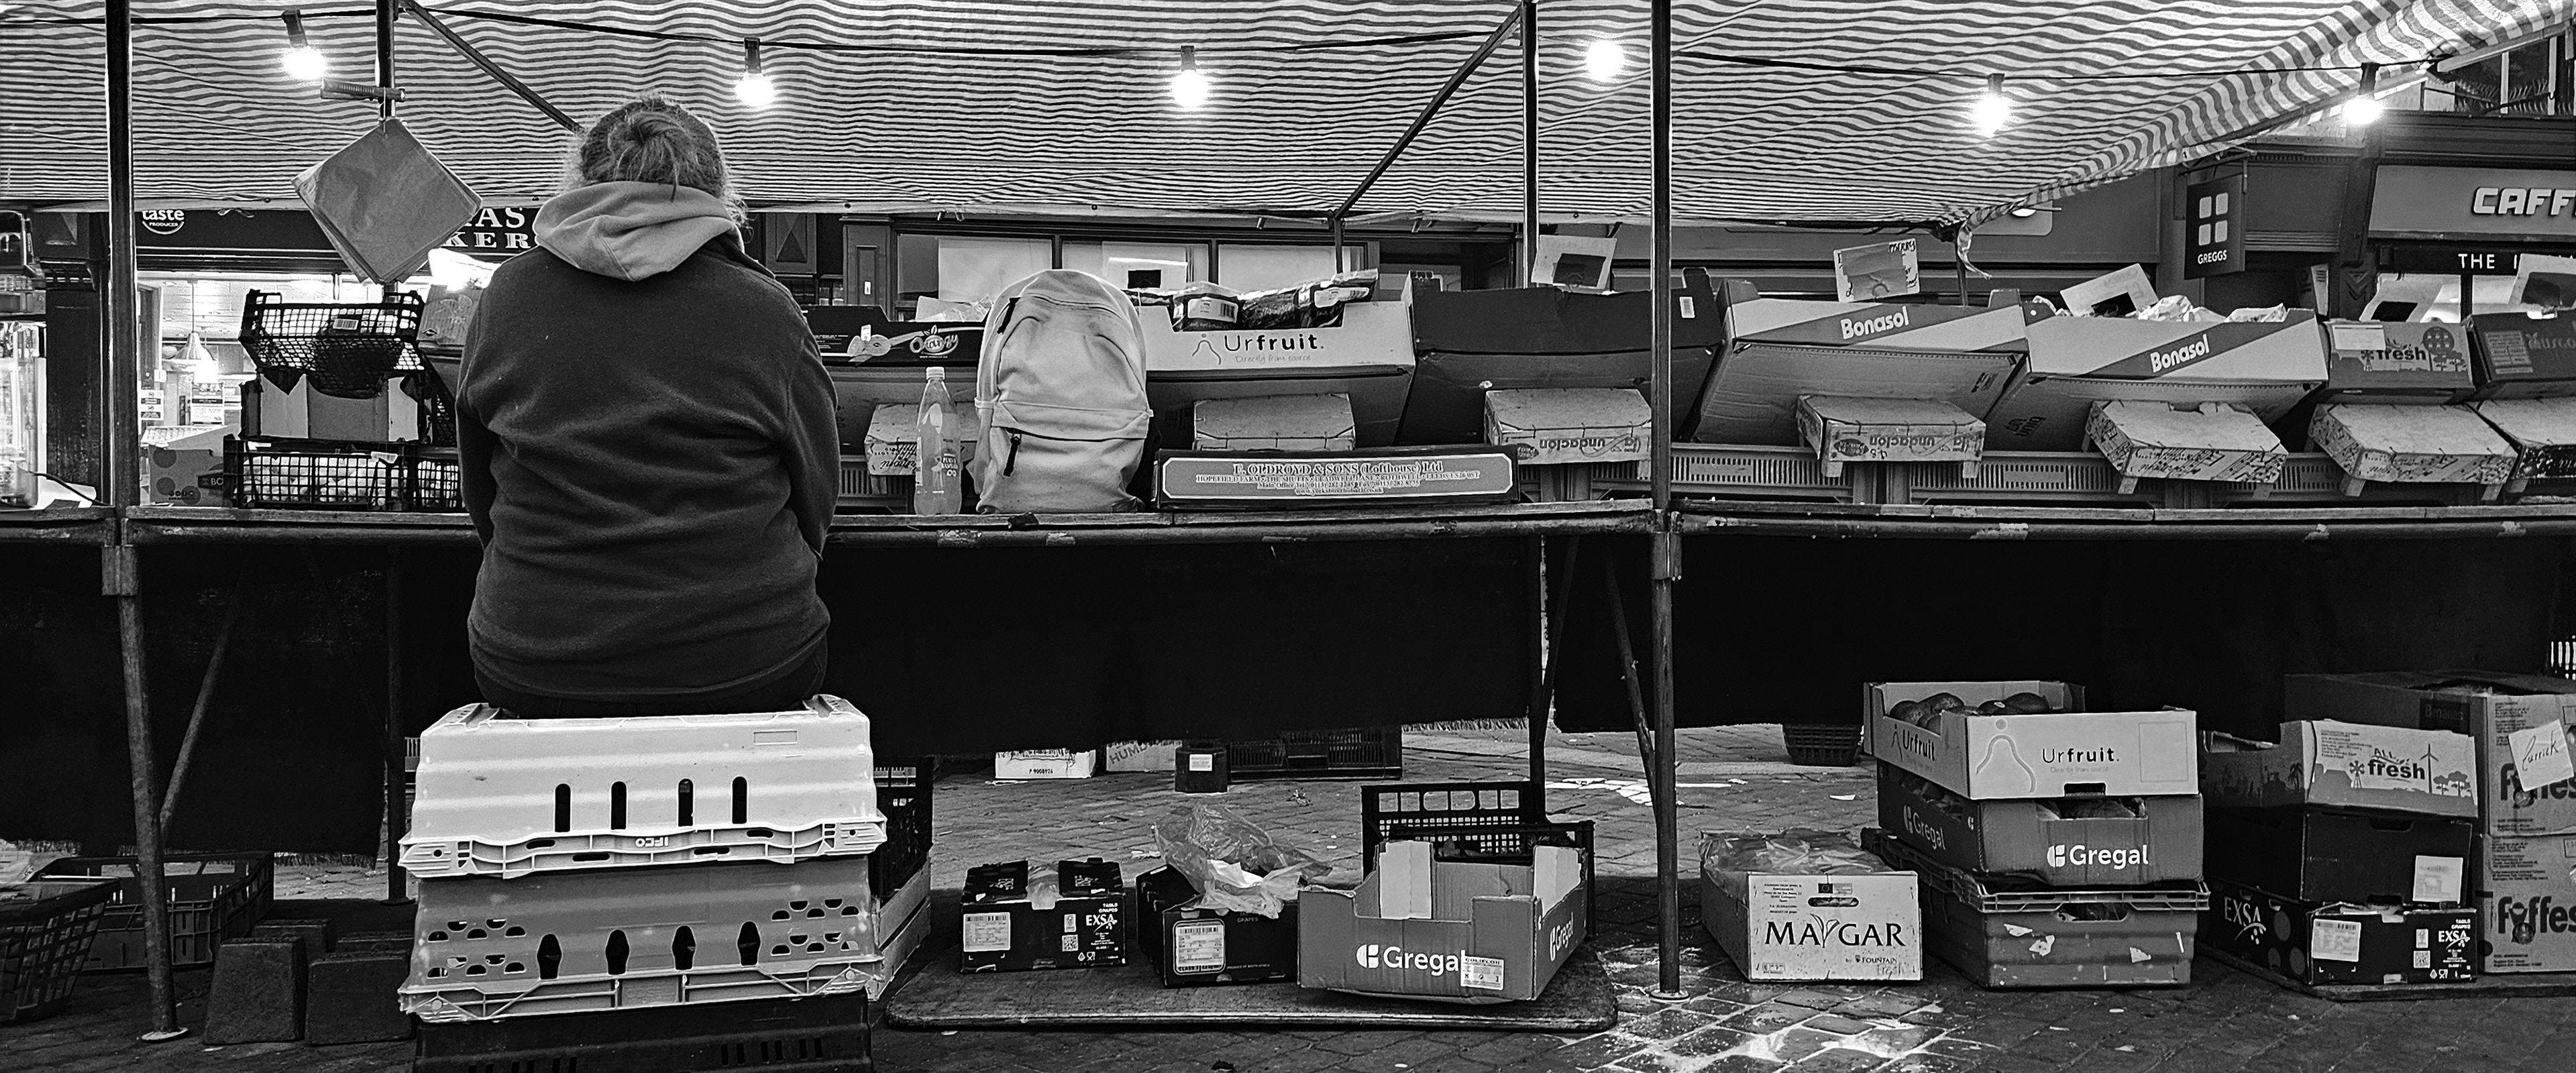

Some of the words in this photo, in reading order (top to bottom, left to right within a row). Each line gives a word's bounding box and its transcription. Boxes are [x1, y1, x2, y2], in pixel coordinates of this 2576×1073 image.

[142, 210, 184, 221] taste
[2198, 249, 2227, 265] GREGGS
[2458, 253, 2495, 269] THE
[1840, 305, 1909, 340] Bonasol
[2150, 333, 2210, 373] Bonasol
[1248, 463, 1311, 475] OLDROYD
[1313, 463, 1324, 474] &
[1326, 462, 1359, 475] SONS
[1422, 461, 1443, 473] Ltd
[2367, 758, 2425, 780] fresh
[1913, 811, 1946, 850] Gregal
[635, 836, 669, 848] IFCO
[2070, 844, 2149, 870] Gregal
[1086, 914, 1116, 926] EXSA
[2224, 895, 2263, 934] EXSA
[2438, 929, 2469, 942] EXSA
